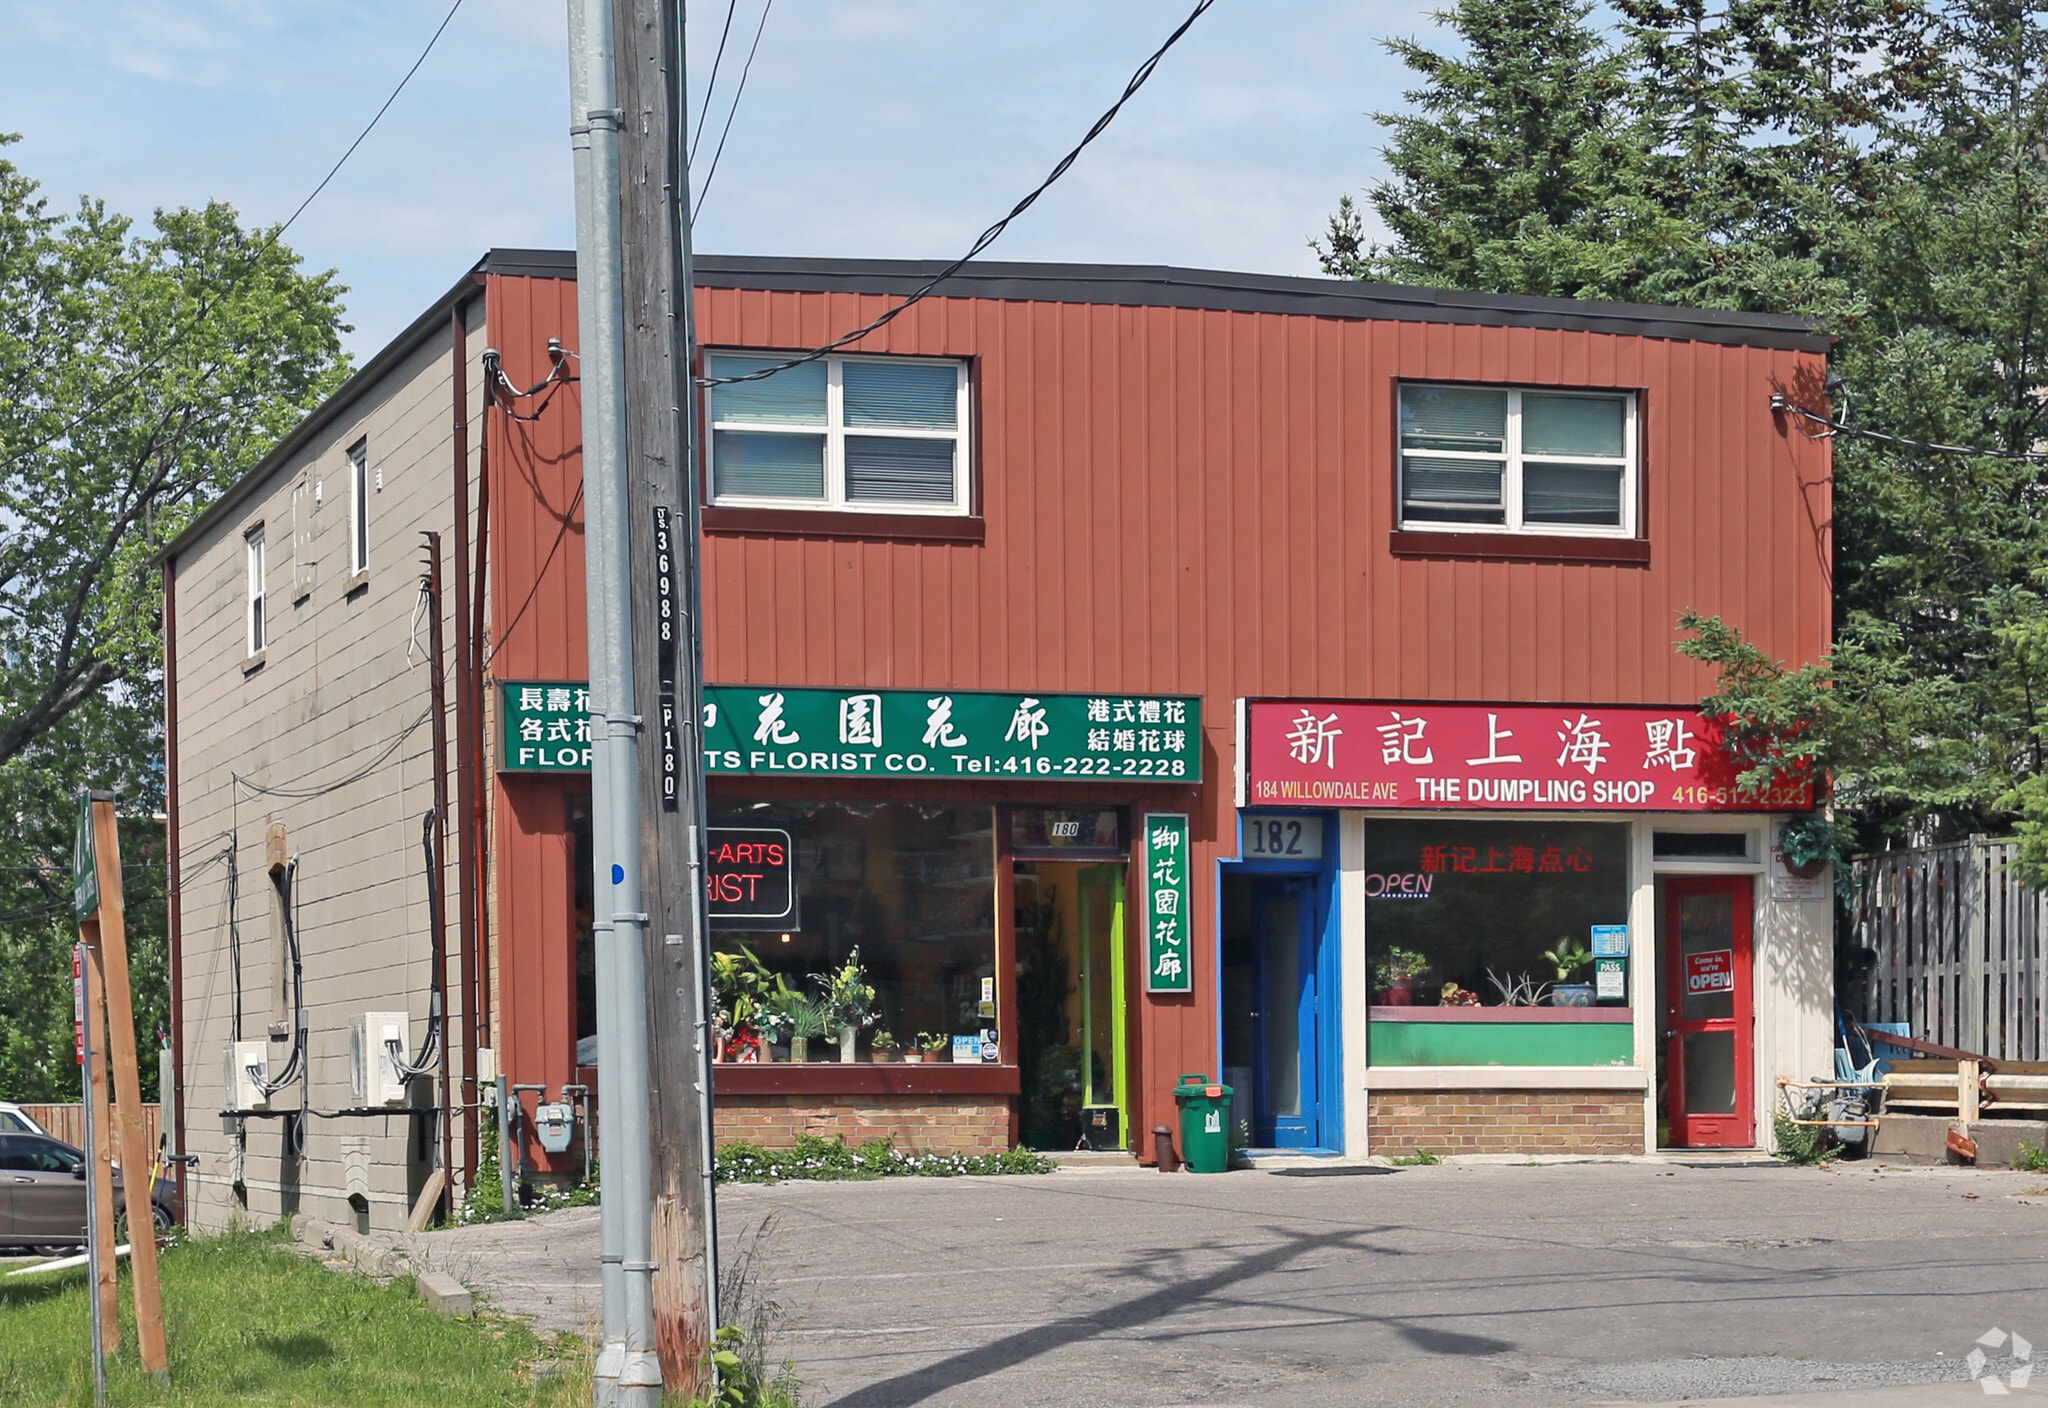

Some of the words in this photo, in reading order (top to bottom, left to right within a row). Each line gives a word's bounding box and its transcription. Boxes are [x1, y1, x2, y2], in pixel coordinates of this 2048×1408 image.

[1087, 698, 1186, 725] 港式禮花
[1087, 728, 1186, 753] 結婚花球
[750, 751, 876, 771] FLORIST
[884, 753, 935, 772] CO.
[1256, 781, 1278, 798] 184
[1281, 781, 1369, 800] WILLOWDALE
[1372, 782, 1398, 800] AVE
[1415, 778, 1461, 802] THE
[1468, 778, 1586, 803] DUMPLING
[1593, 780, 1655, 804] SHOP
[1672, 786, 1806, 805] 416-512-2323
[1055, 823, 1077, 836] 180
[1253, 820, 1302, 854] 182
[1420, 845, 1593, 873] 新记上海点心
[1365, 873, 1434, 897] OPEN
[1152, 825, 1182, 982] 御花園花廊
[1601, 963, 1621, 973] PASS
[1689, 972, 1731, 990] OPEN
